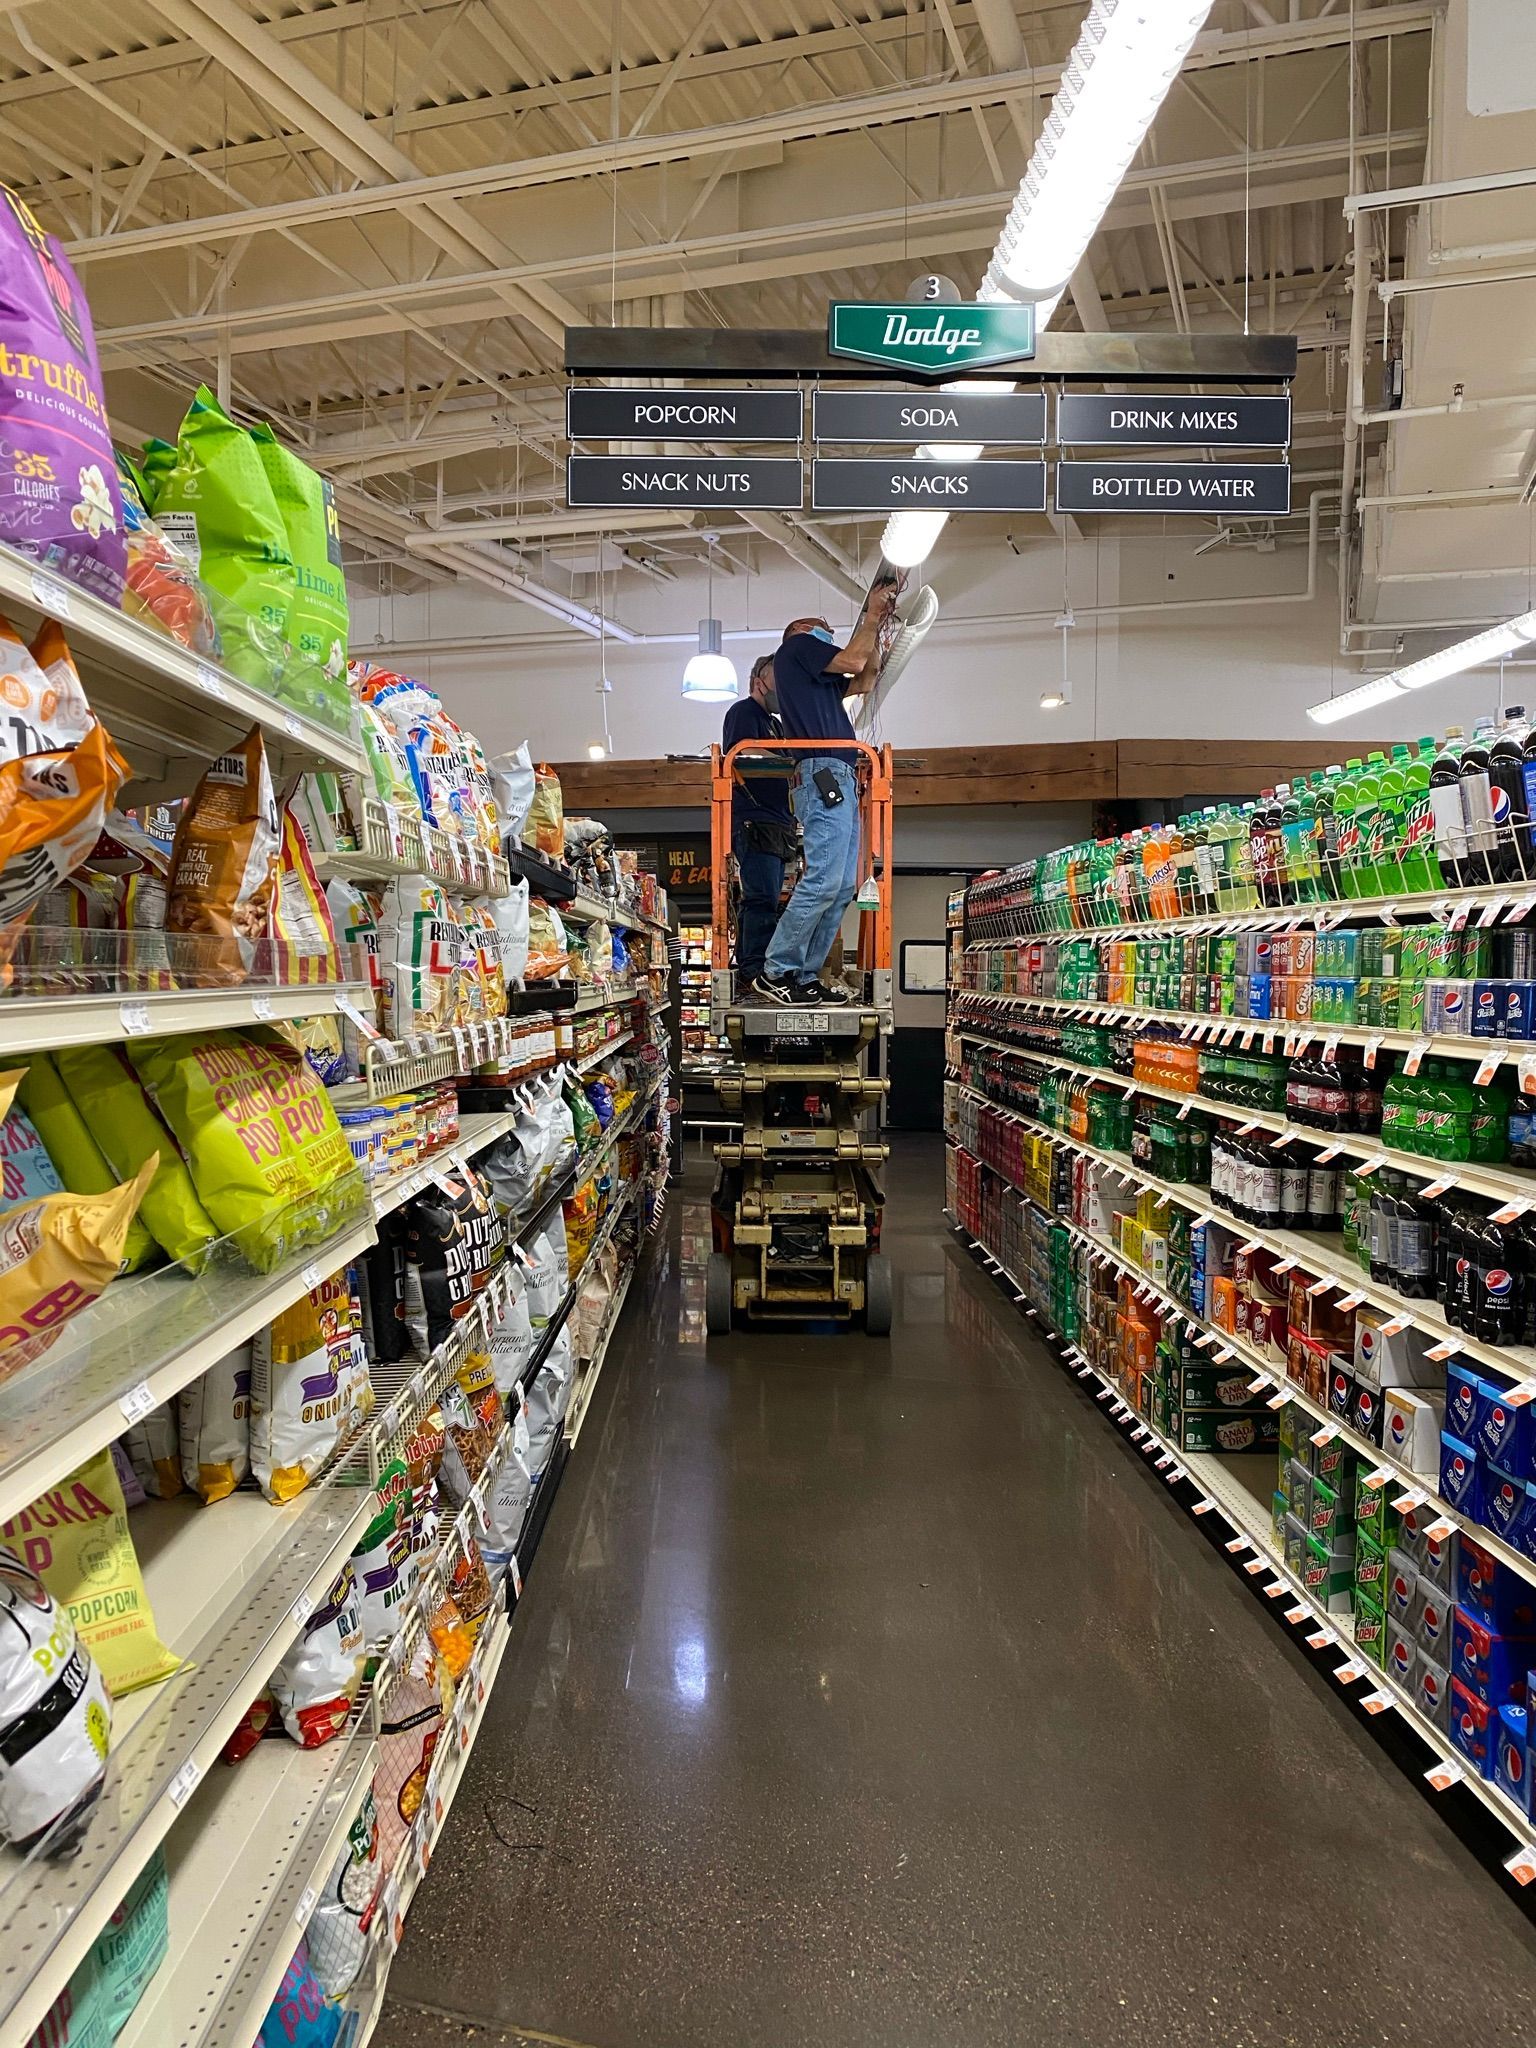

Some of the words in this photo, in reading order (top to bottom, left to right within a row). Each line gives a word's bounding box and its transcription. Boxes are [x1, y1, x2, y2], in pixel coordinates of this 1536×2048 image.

[925, 275, 941, 299] 3
[882, 314, 983, 355] Dodge
[16, 388, 76, 419] DELICIOUS
[634, 405, 736, 425] POPCORN
[900, 407, 959, 427] SODA
[1110, 410, 1174, 430] DRINK
[1179, 411, 1238, 430] MIXES
[14, 449, 56, 482] 35
[14, 477, 61, 503] CALORIES
[621, 472, 689, 492] SNACK
[696, 473, 751, 492] NUTS
[890, 475, 969, 495] SNACKS
[1092, 477, 1182, 497] BOTTLED
[1187, 479, 1256, 498] WATER
[181, 532, 196, 541] 140
[300, 632, 322, 652] 35
[186, 848, 207, 863] REAL
[669, 851, 695, 867] HEAT
[280, 1095, 327, 1145] POP
[1486, 1296, 1510, 1306] pepsi
